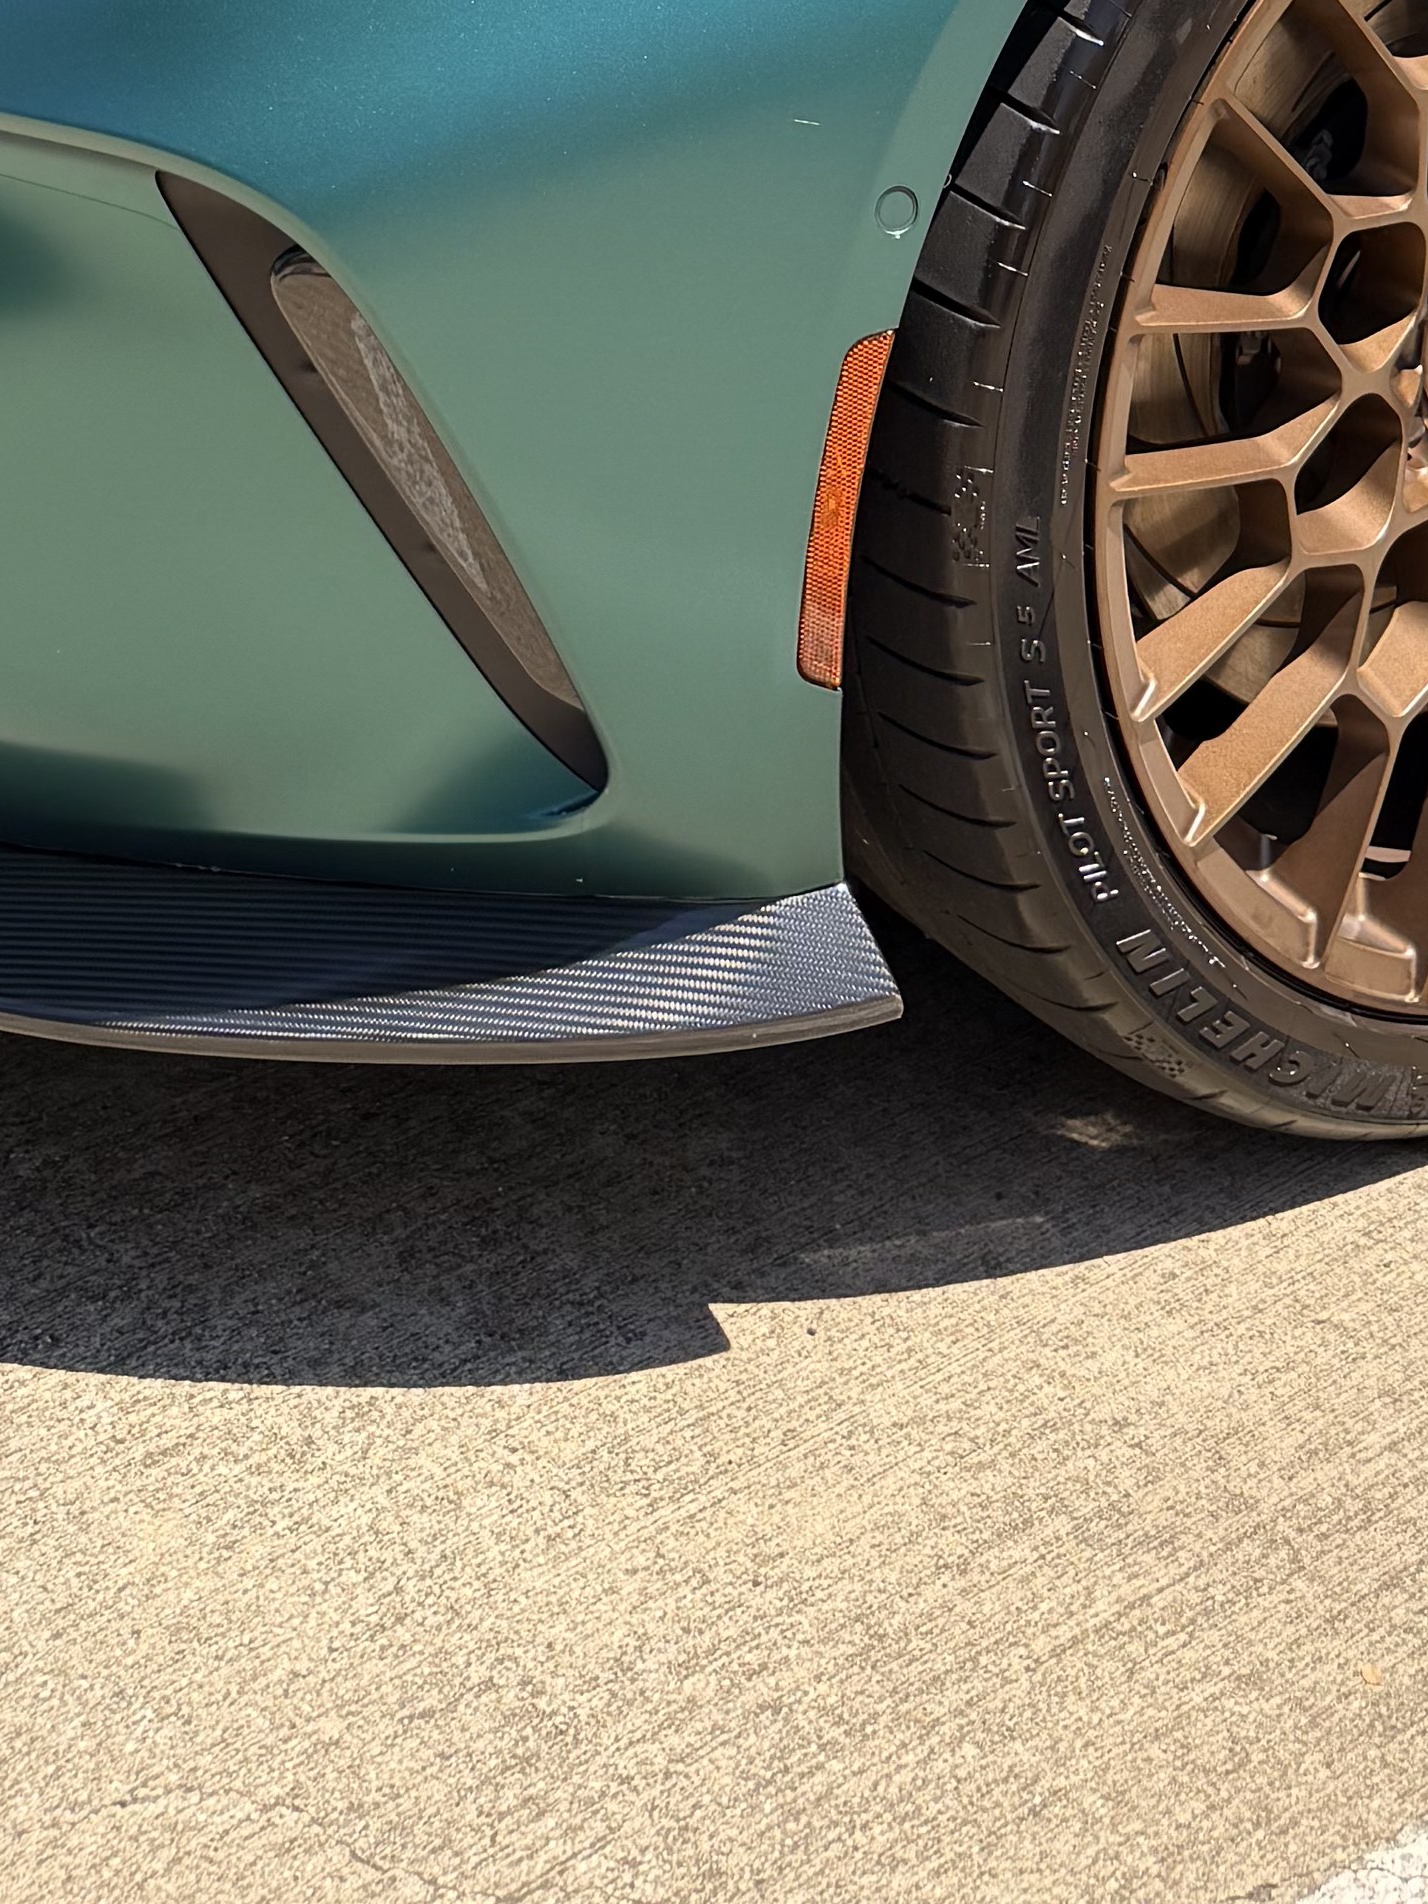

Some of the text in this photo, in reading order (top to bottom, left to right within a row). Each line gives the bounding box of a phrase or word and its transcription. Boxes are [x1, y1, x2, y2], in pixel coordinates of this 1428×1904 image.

[1014, 515, 1042, 588] AML
[1023, 681, 1076, 802] SPORT
[1058, 815, 1121, 905] PILOT
[1115, 927, 1398, 1111] MICHELIN
